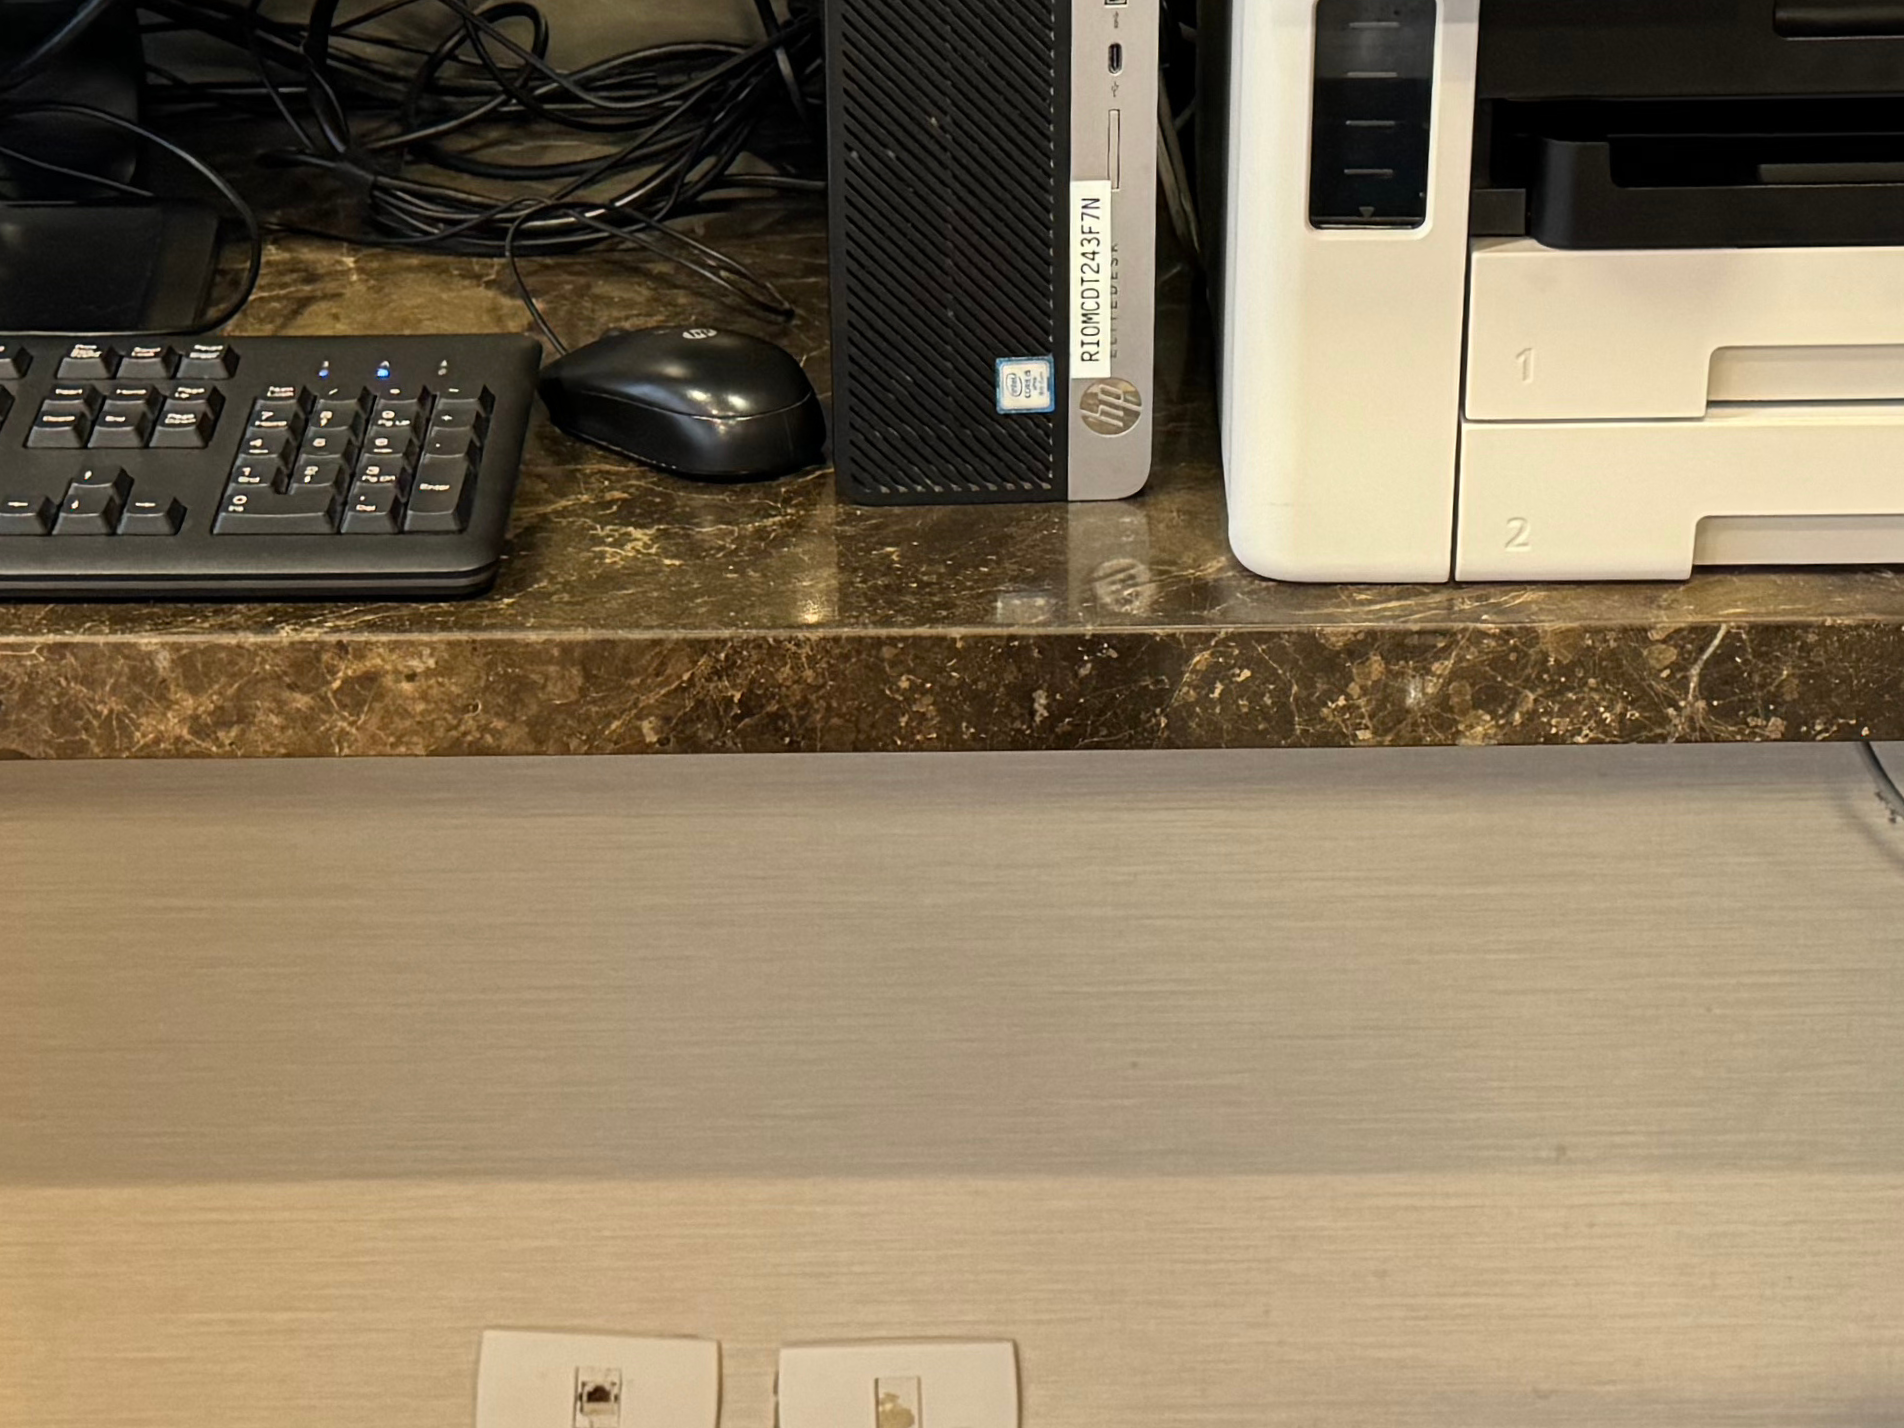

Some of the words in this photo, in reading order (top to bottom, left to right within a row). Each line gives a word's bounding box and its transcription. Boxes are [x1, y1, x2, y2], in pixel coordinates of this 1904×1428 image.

[1514, 345, 1536, 385] 1
[1079, 379, 1143, 432] hp
[1504, 516, 1531, 553] 2
